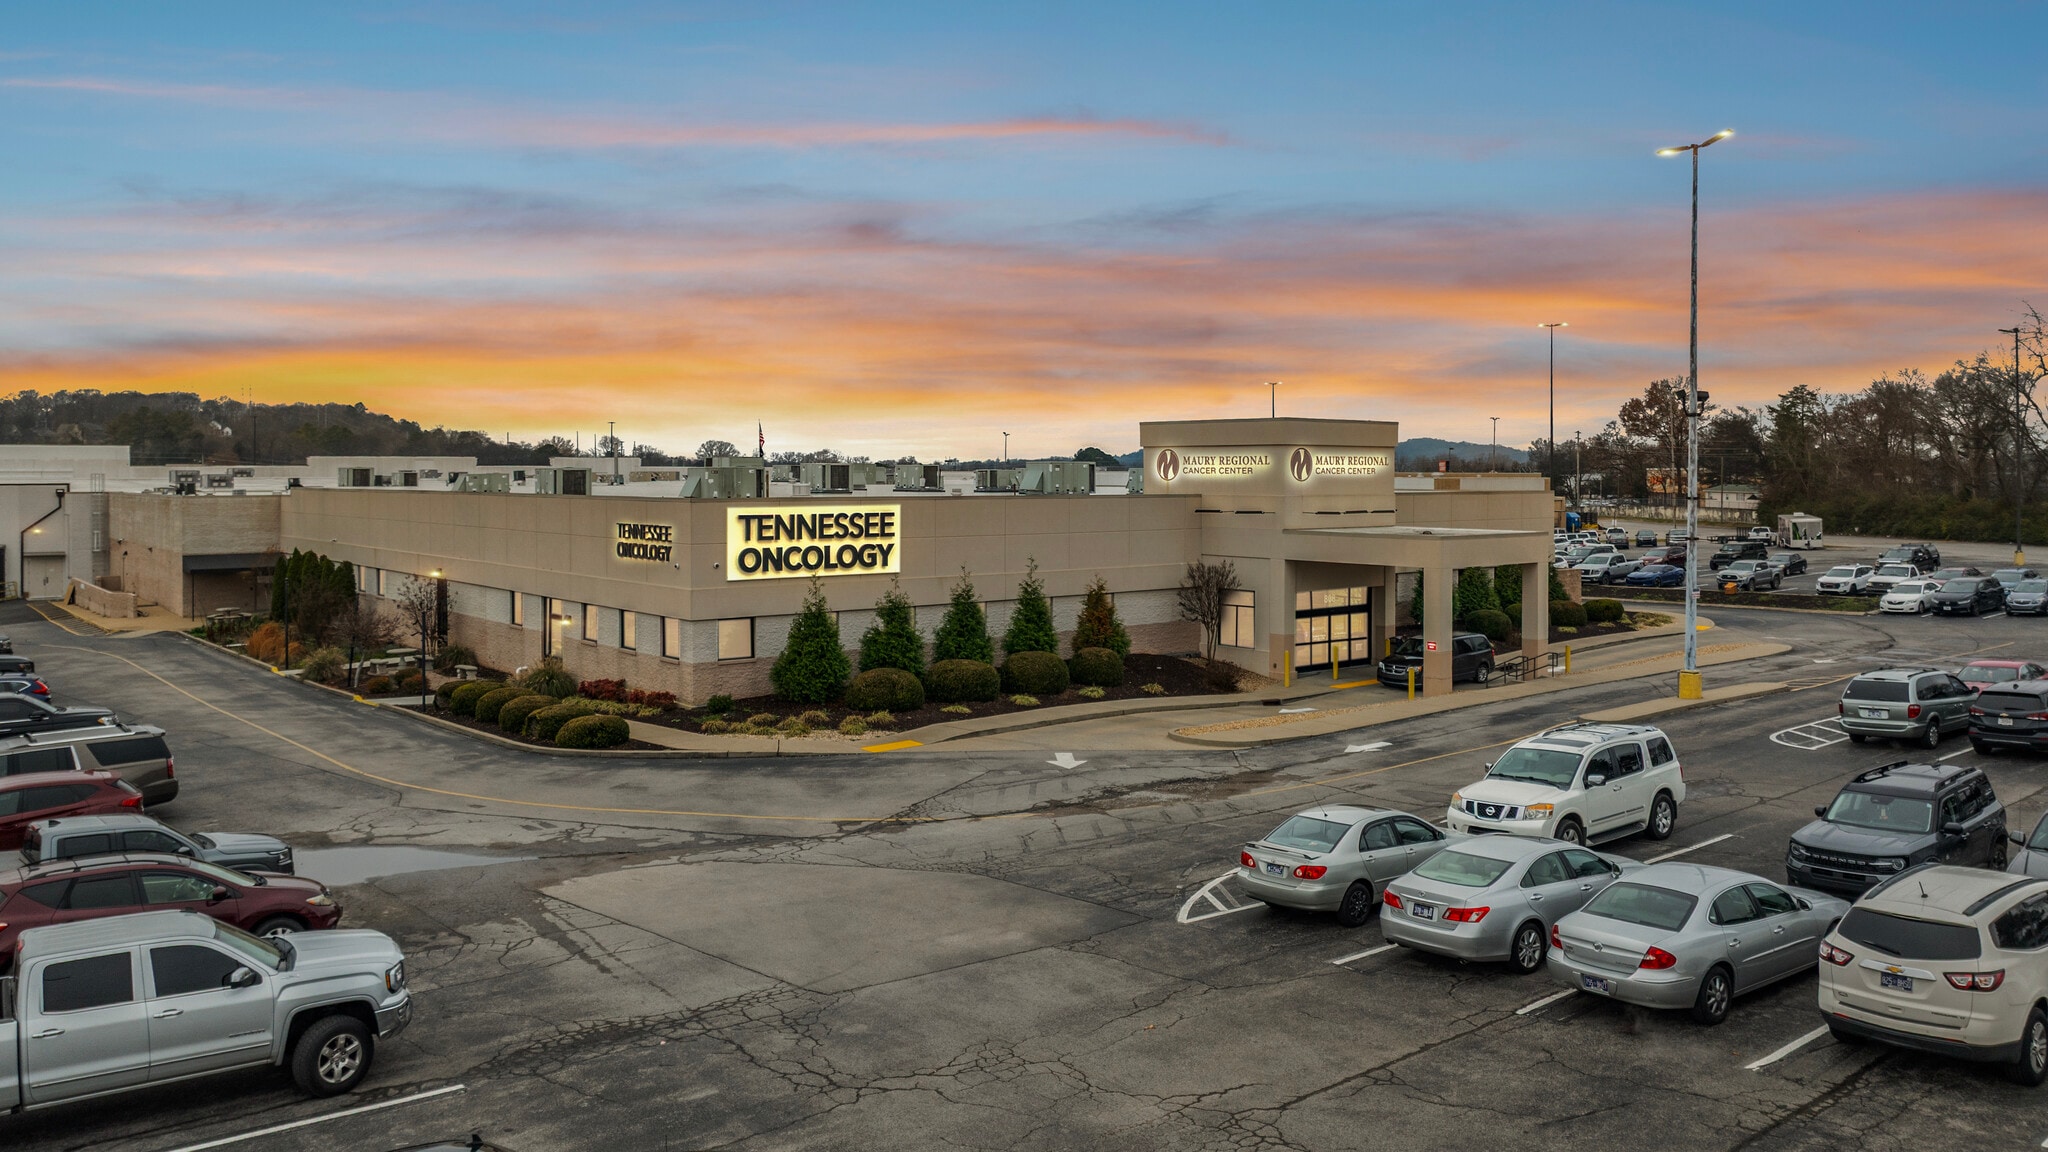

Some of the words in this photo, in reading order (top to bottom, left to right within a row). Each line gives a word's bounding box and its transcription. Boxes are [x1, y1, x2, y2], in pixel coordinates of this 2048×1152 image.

[1183, 455, 1216, 465] MAURY
[1218, 455, 1270, 465] REGIONAL
[1315, 455, 1346, 465] MAURY
[1348, 455, 1389, 466] REGIONAL
[616, 522, 672, 543] TENNESSEE
[738, 512, 895, 541] TENNESSEE
[616, 541, 672, 562] ONCOLOGY
[738, 543, 894, 573] ONCOLOGY
